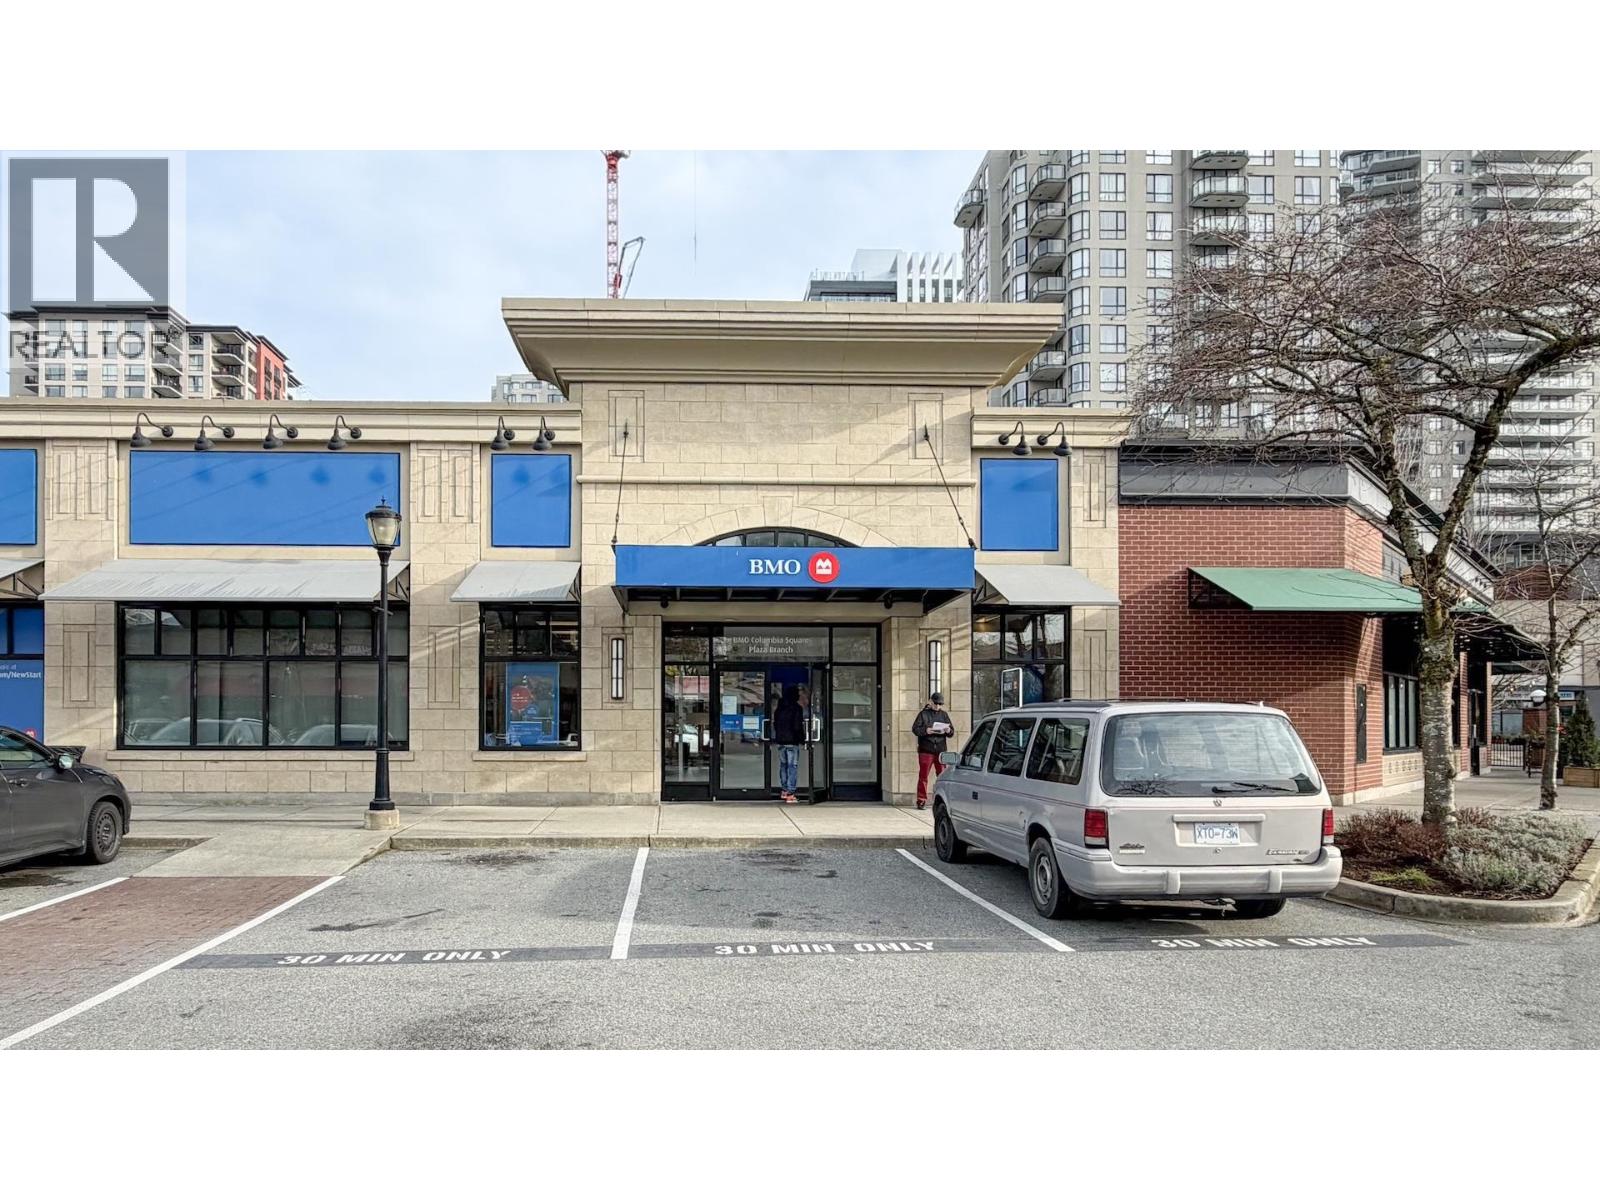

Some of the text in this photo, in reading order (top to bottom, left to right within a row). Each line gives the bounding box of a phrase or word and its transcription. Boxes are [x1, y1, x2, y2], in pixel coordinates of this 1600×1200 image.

[749, 559, 801, 575] BMO
[732, 636, 809, 646] BMO Columbia Square
[714, 941, 934, 955] 30 MIN ONLY
[1151, 937, 1377, 948] 30 MIN ONLY
[277, 950, 511, 965] 30 MIN ONLY
